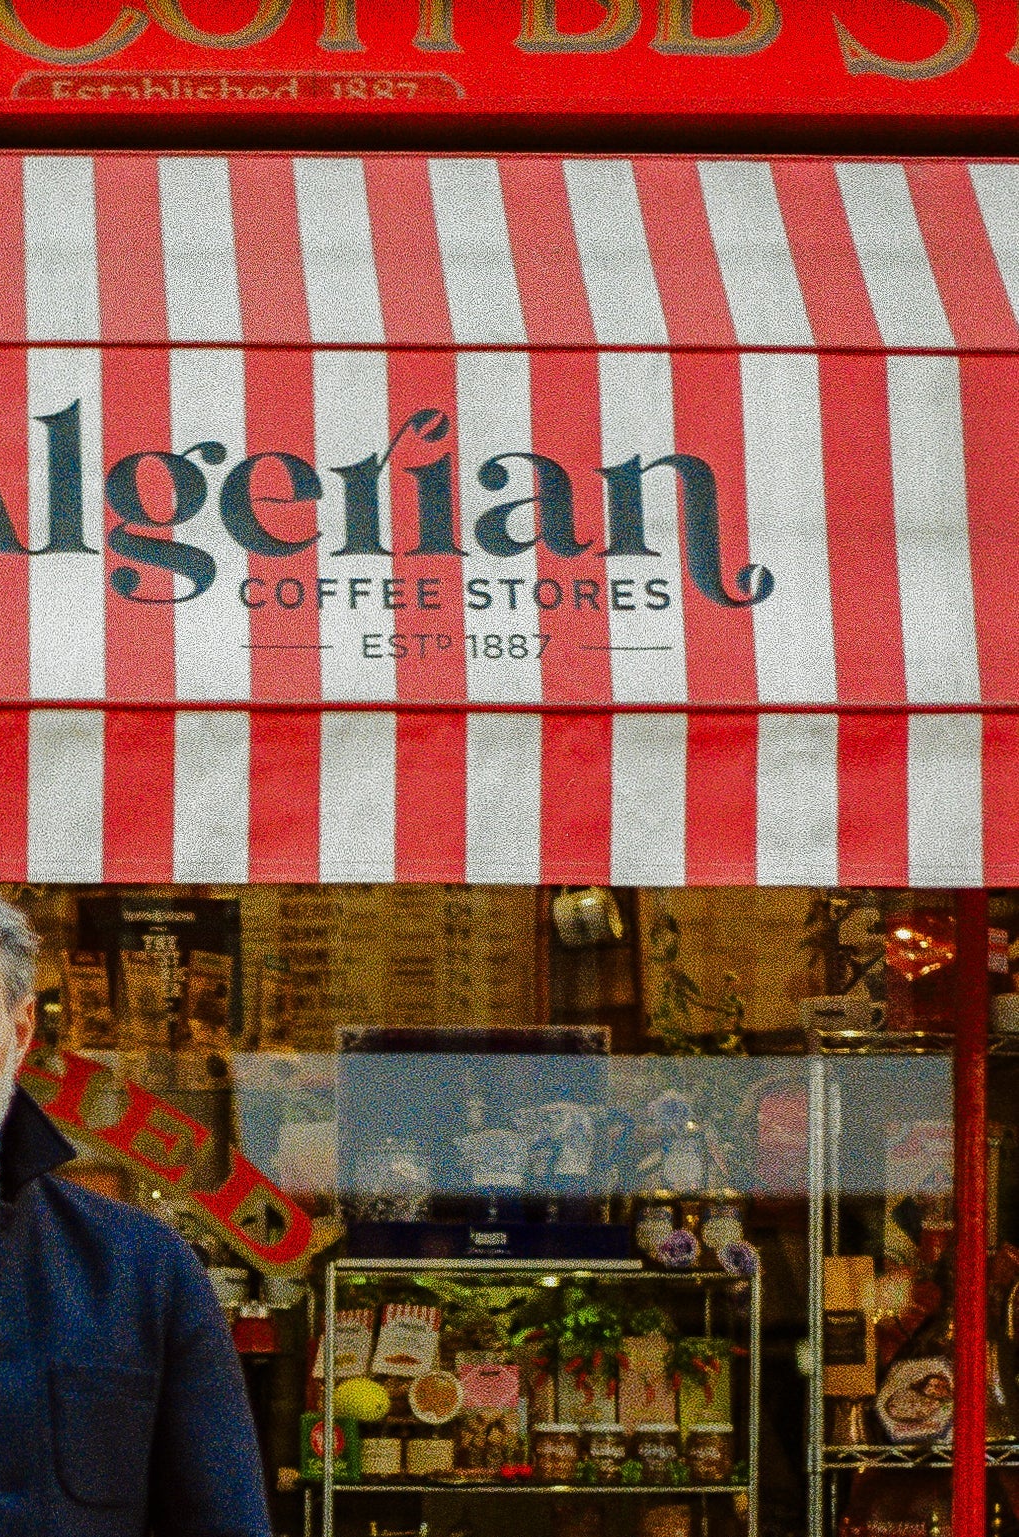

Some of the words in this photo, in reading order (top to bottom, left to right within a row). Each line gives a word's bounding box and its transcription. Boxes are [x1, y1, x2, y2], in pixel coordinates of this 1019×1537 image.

[239, 577, 443, 612] COFFEE
[466, 578, 673, 613] STORES
[465, 633, 553, 661] 1887
